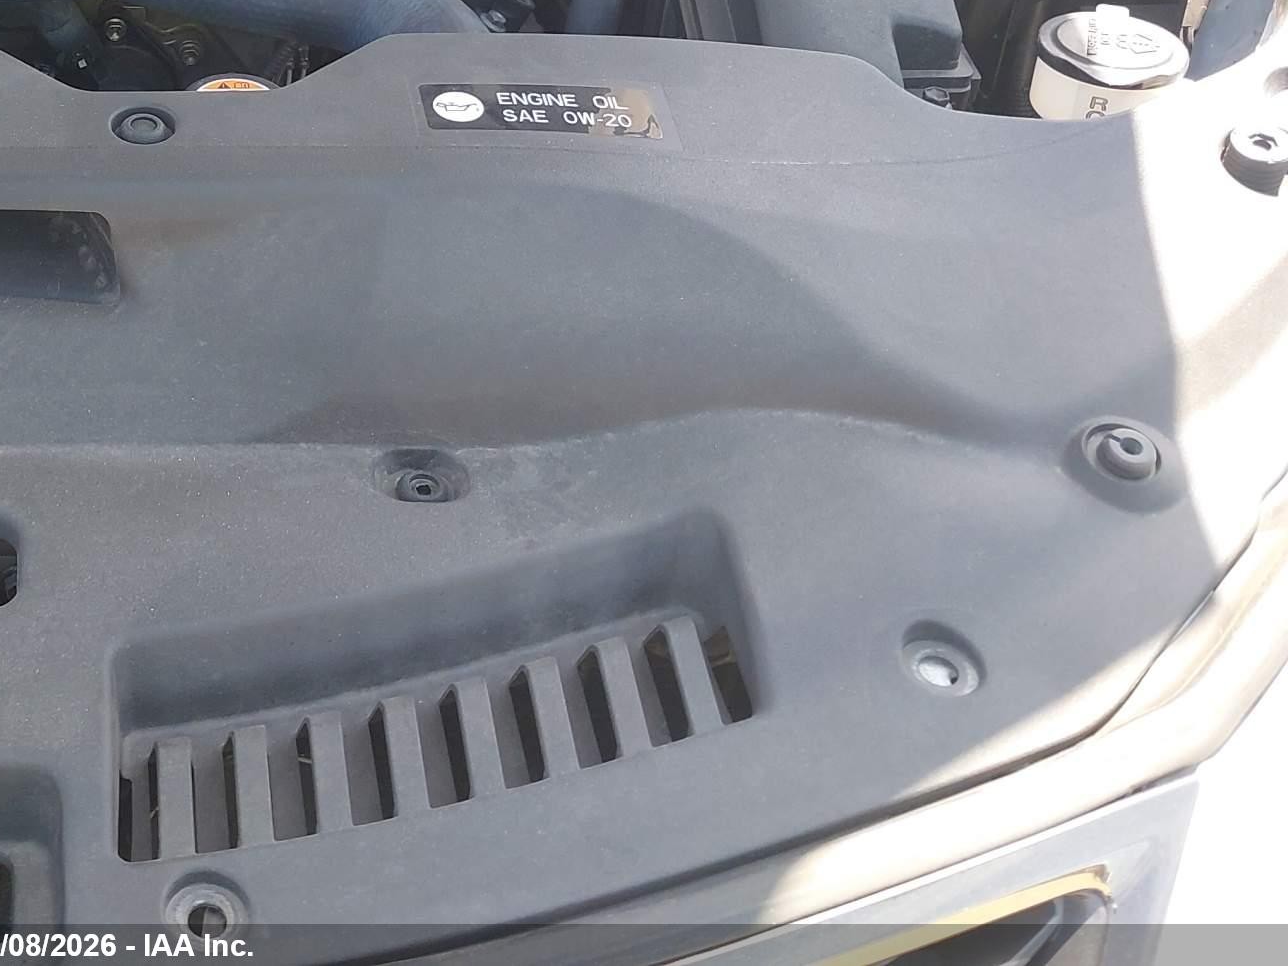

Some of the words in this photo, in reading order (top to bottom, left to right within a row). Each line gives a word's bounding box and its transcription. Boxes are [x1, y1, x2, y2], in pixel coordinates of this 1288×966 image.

[496, 92, 578, 108] ENGINE
[593, 95, 629, 110] OIL
[503, 109, 549, 123] SAE
[563, 111, 632, 128] 0W-20
